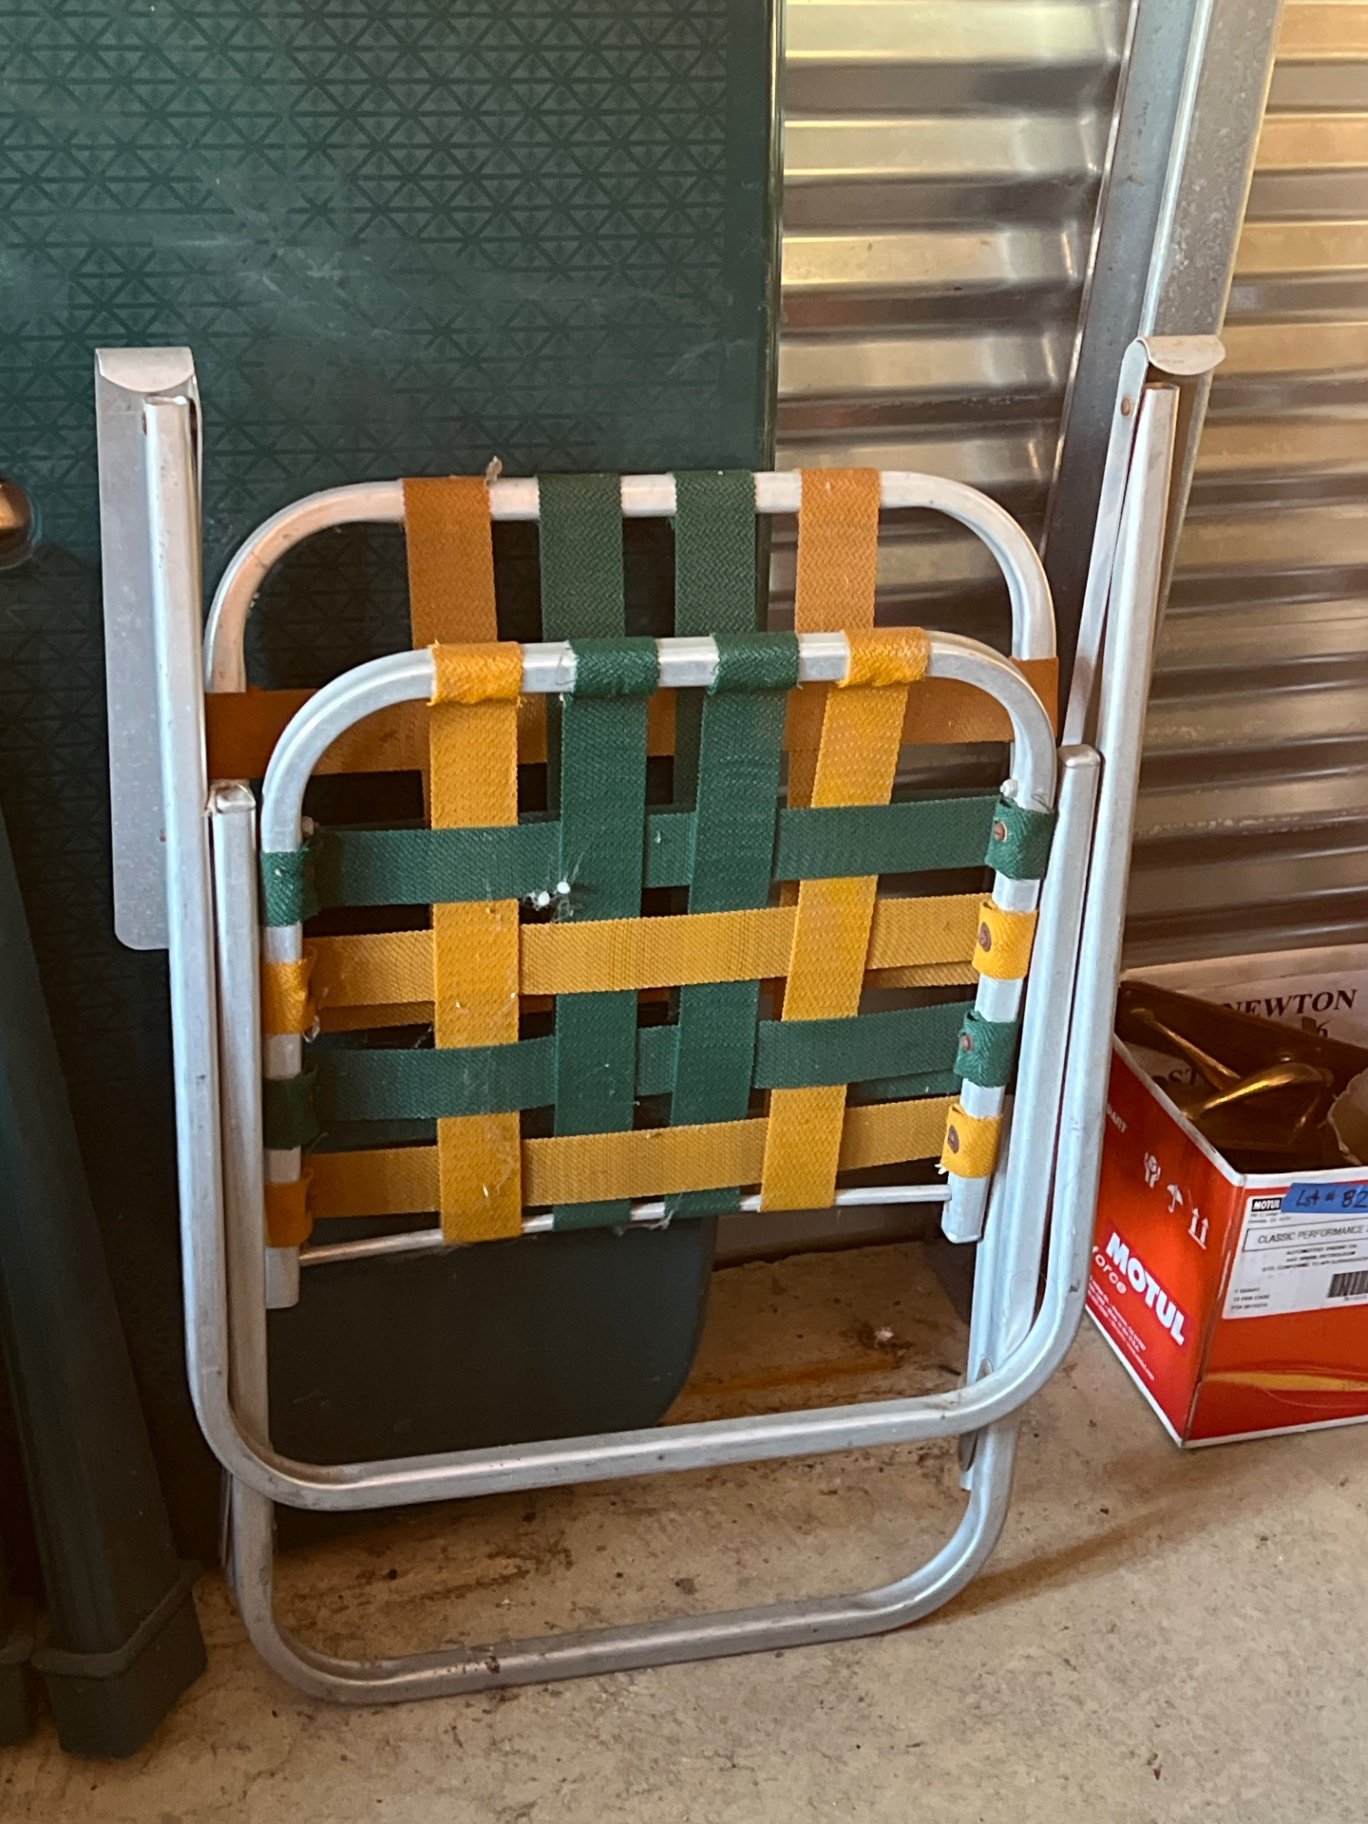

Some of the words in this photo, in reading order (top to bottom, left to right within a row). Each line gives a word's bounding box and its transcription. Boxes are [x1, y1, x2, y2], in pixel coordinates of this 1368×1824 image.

[1252, 1199, 1281, 1211] MOTUL
[1296, 1189, 1320, 1207] Lot
[1257, 1231, 1296, 1244] CLASSIC
[1298, 1224, 1364, 1240] PERFORMANCE
[1106, 1232, 1185, 1346] MOTUL
